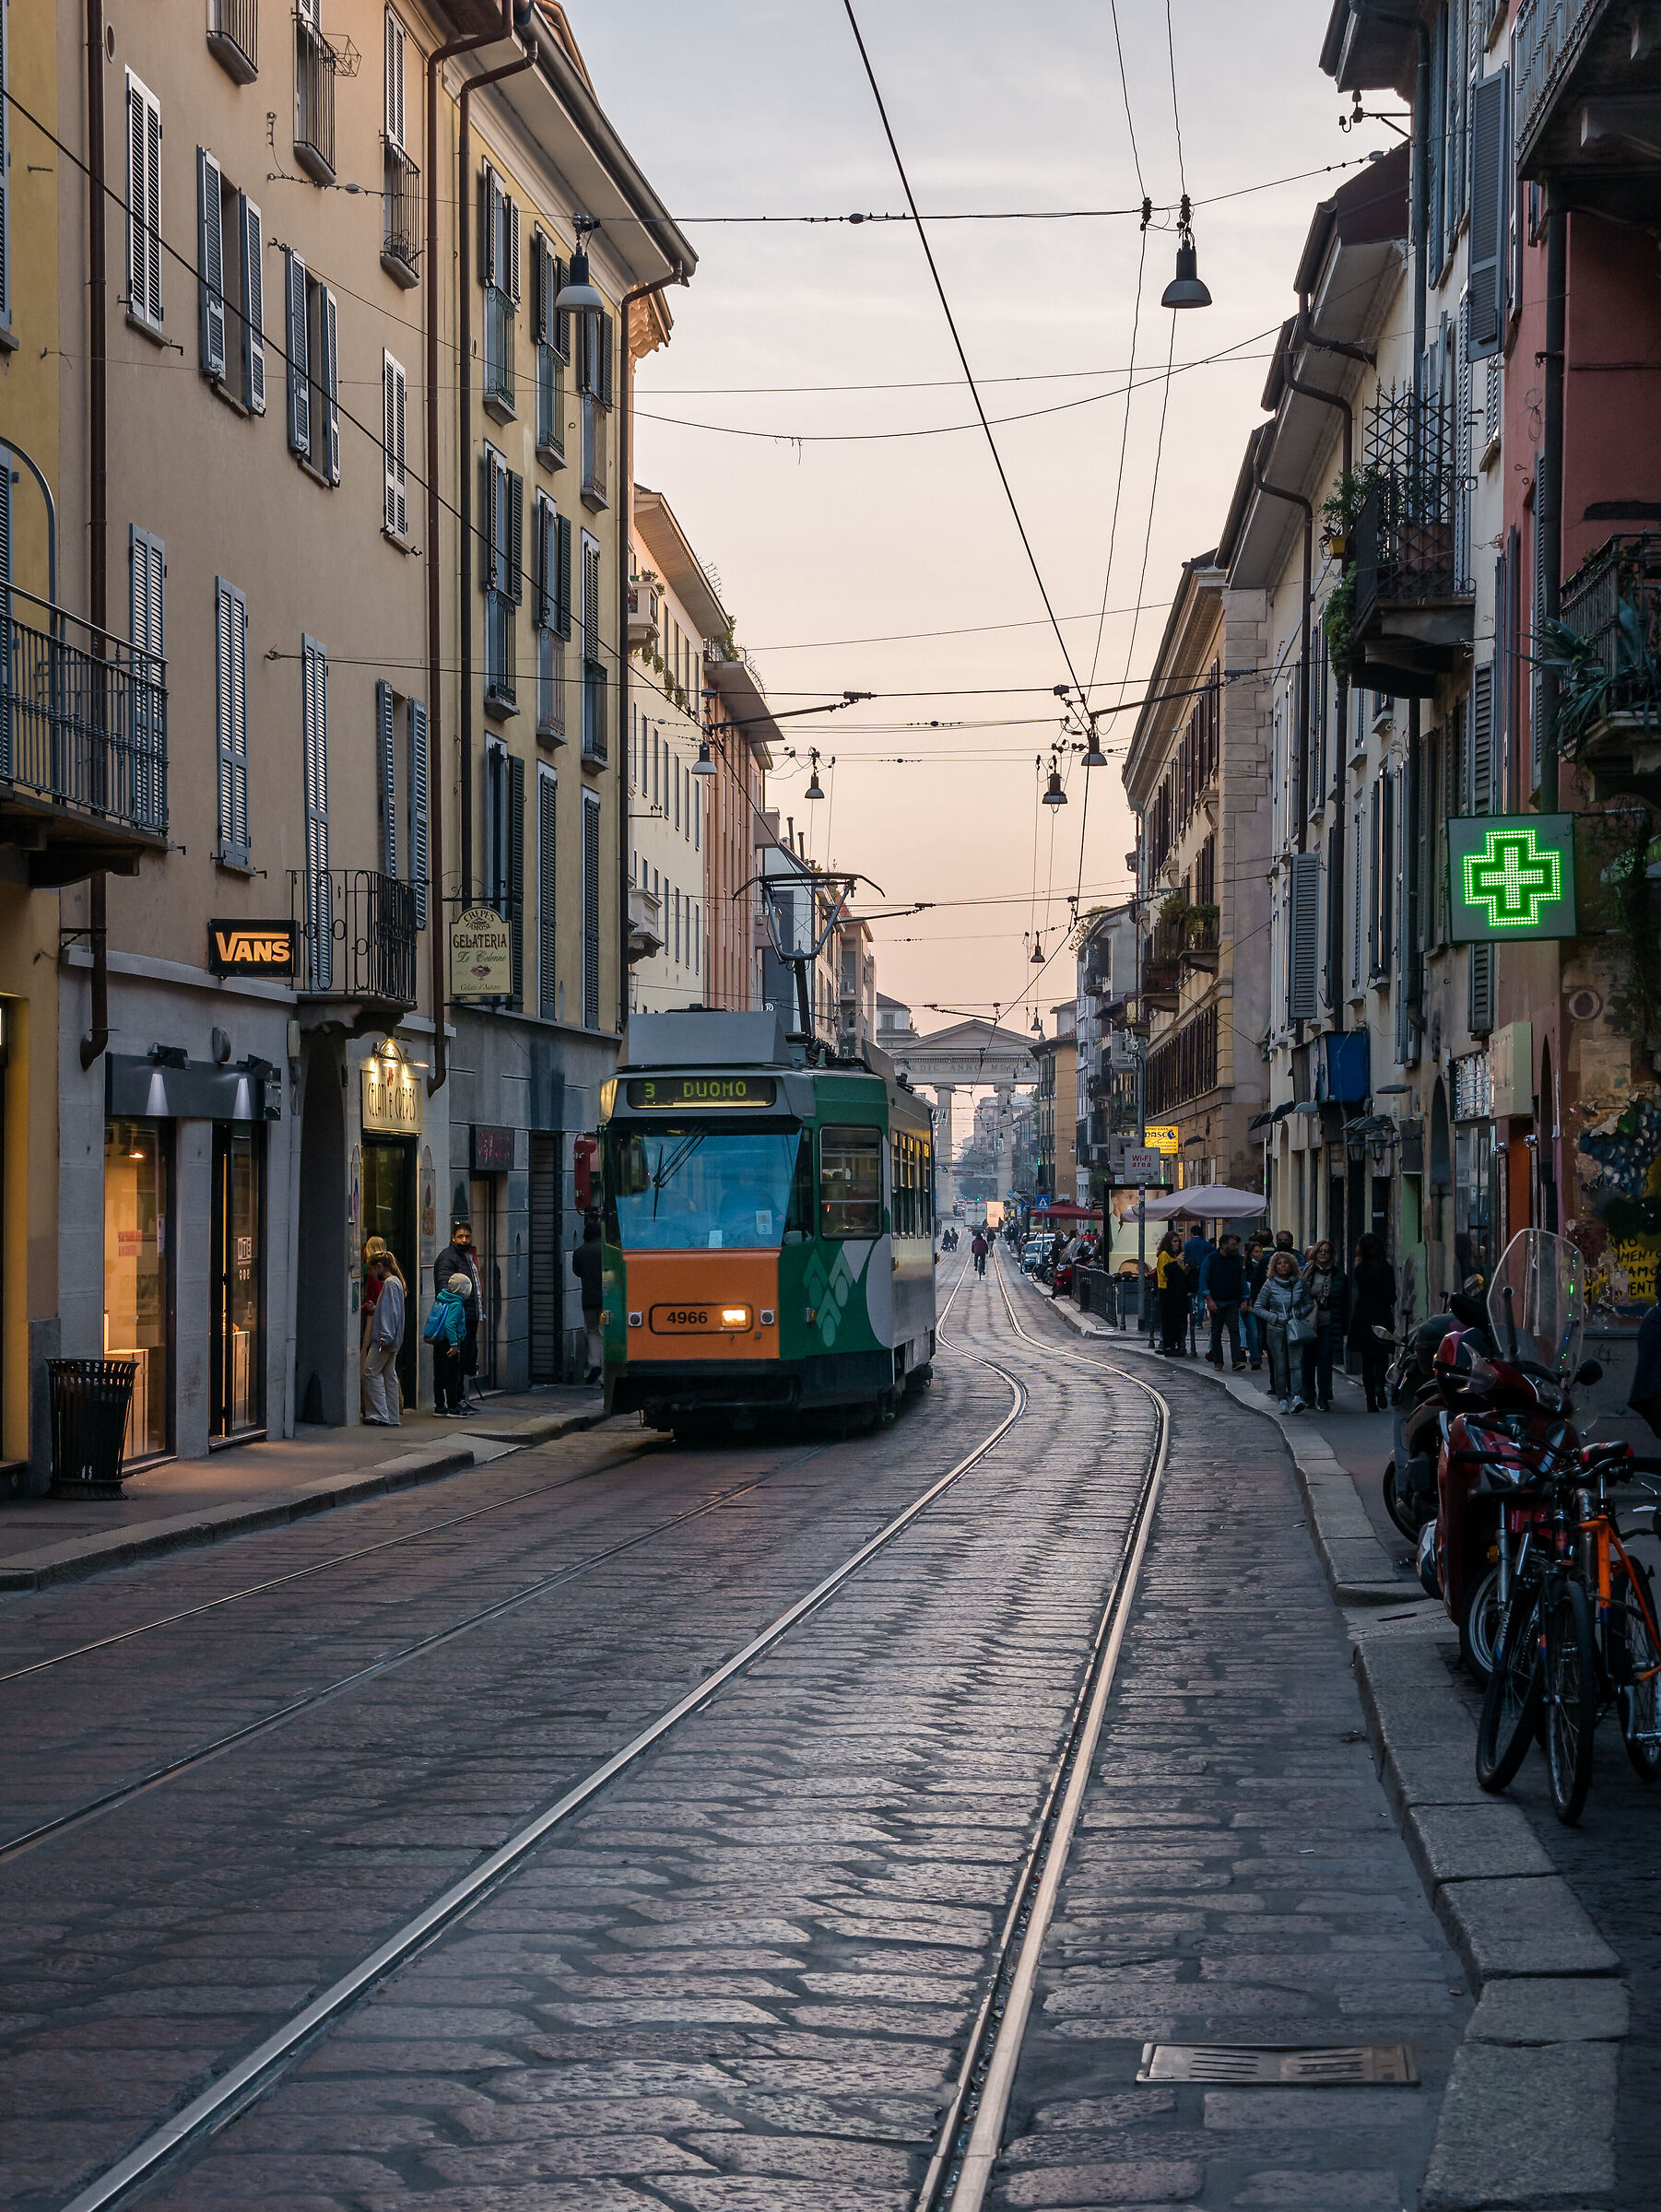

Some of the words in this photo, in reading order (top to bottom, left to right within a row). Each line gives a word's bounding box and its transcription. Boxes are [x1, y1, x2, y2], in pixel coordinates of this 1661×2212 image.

[215, 932, 290, 962] VANS
[453, 934, 507, 949] GELATERIA
[645, 1082, 655, 1099] 3
[683, 1081, 747, 1098] DUOMO
[666, 1312, 708, 1324] 4966
